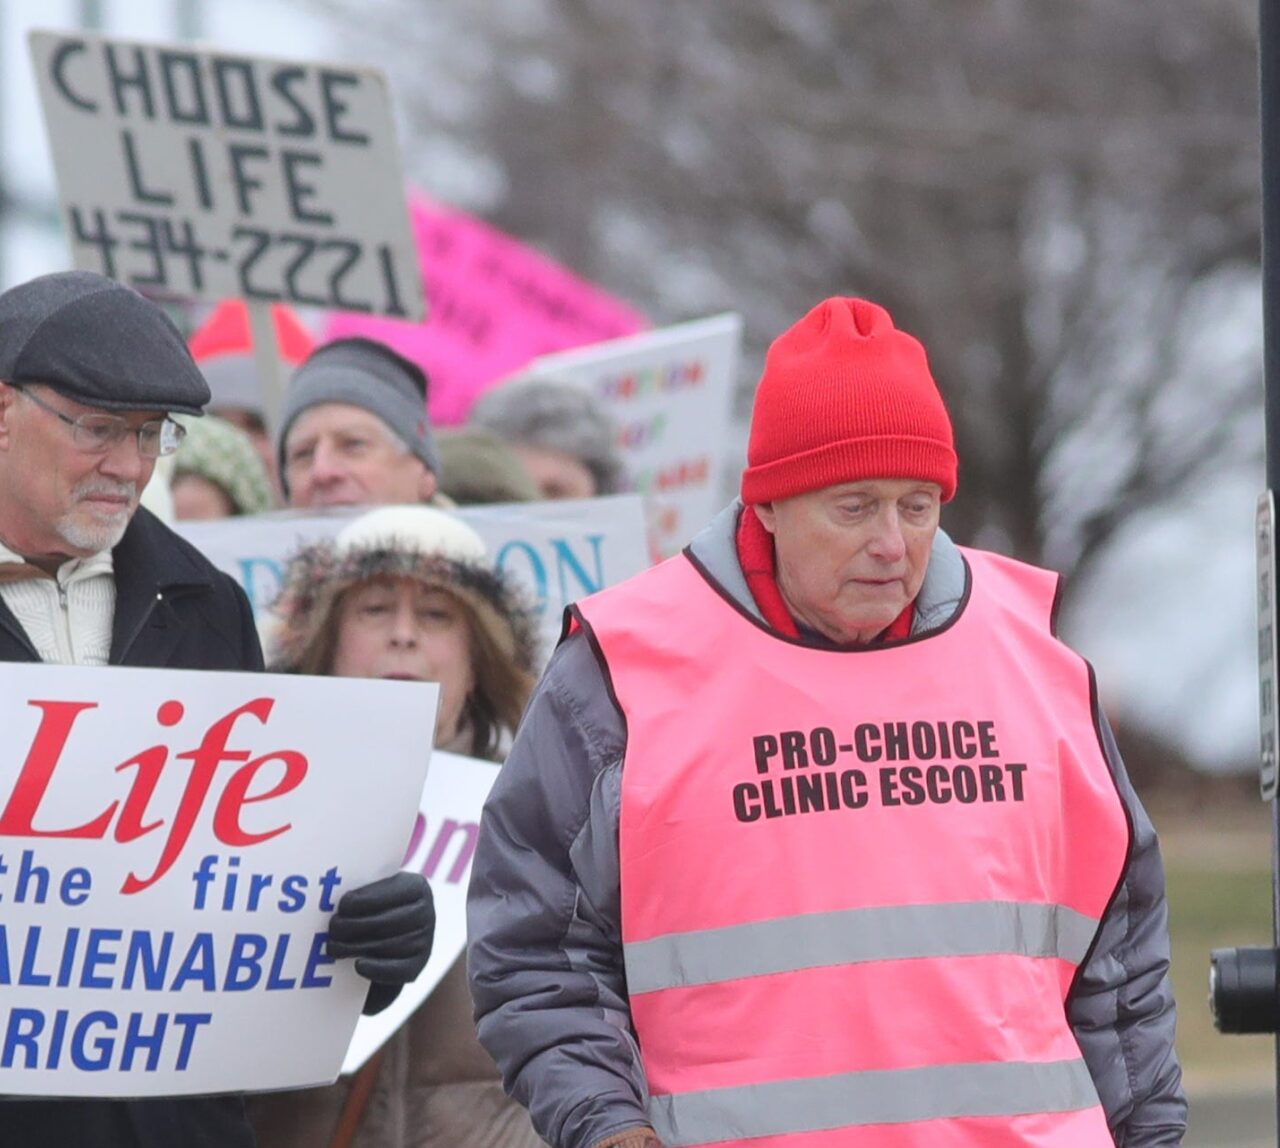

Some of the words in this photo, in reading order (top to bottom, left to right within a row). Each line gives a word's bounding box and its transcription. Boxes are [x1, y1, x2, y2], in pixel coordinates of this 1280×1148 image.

[51, 40, 369, 147] CHOOSE
[122, 130, 335, 227] LIFE
[67, 206, 410, 317] 434-2221
[753, 720, 1000, 775] PRO-CHOICE
[733, 769, 869, 823] CLINIC
[879, 763, 1027, 807] ESCORT
[192, 855, 342, 914] first
[0, 1008, 212, 1072] RIGHT
